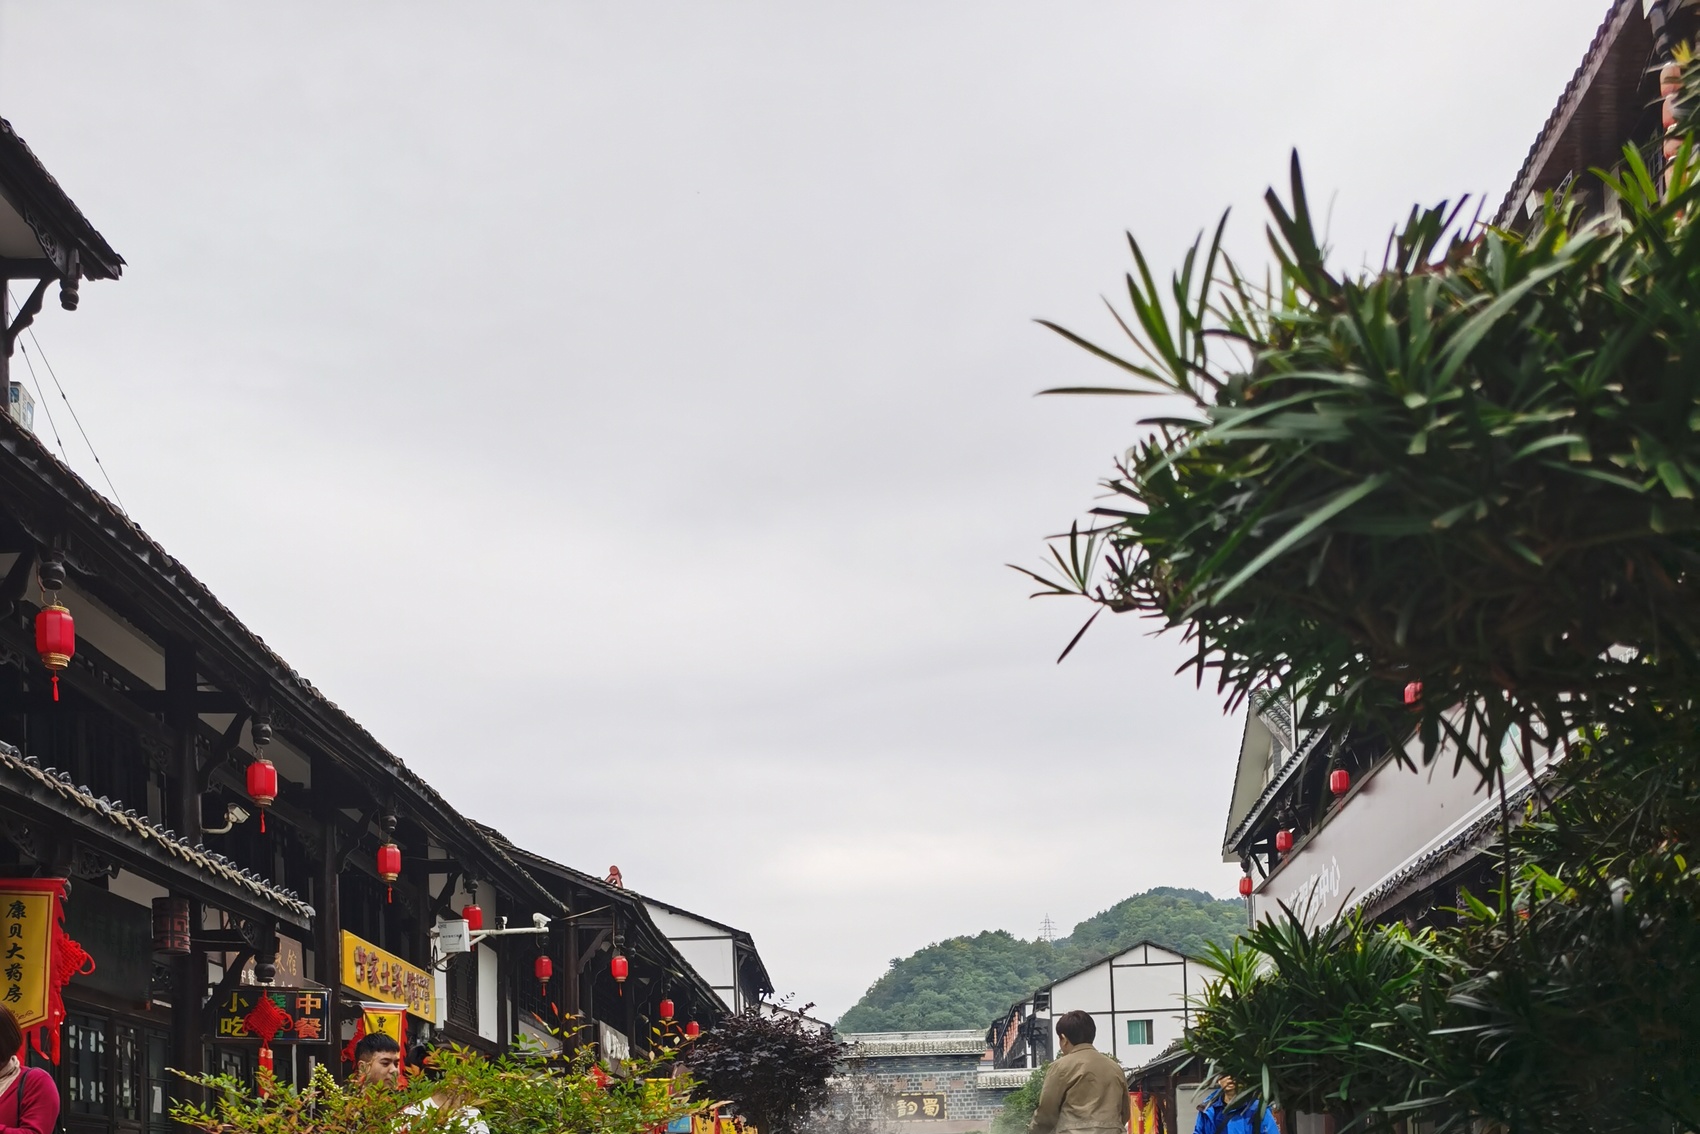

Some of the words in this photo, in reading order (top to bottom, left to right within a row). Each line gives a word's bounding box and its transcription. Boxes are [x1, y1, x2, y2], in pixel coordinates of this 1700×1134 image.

[4, 900, 27, 1003] 康贝大药房
